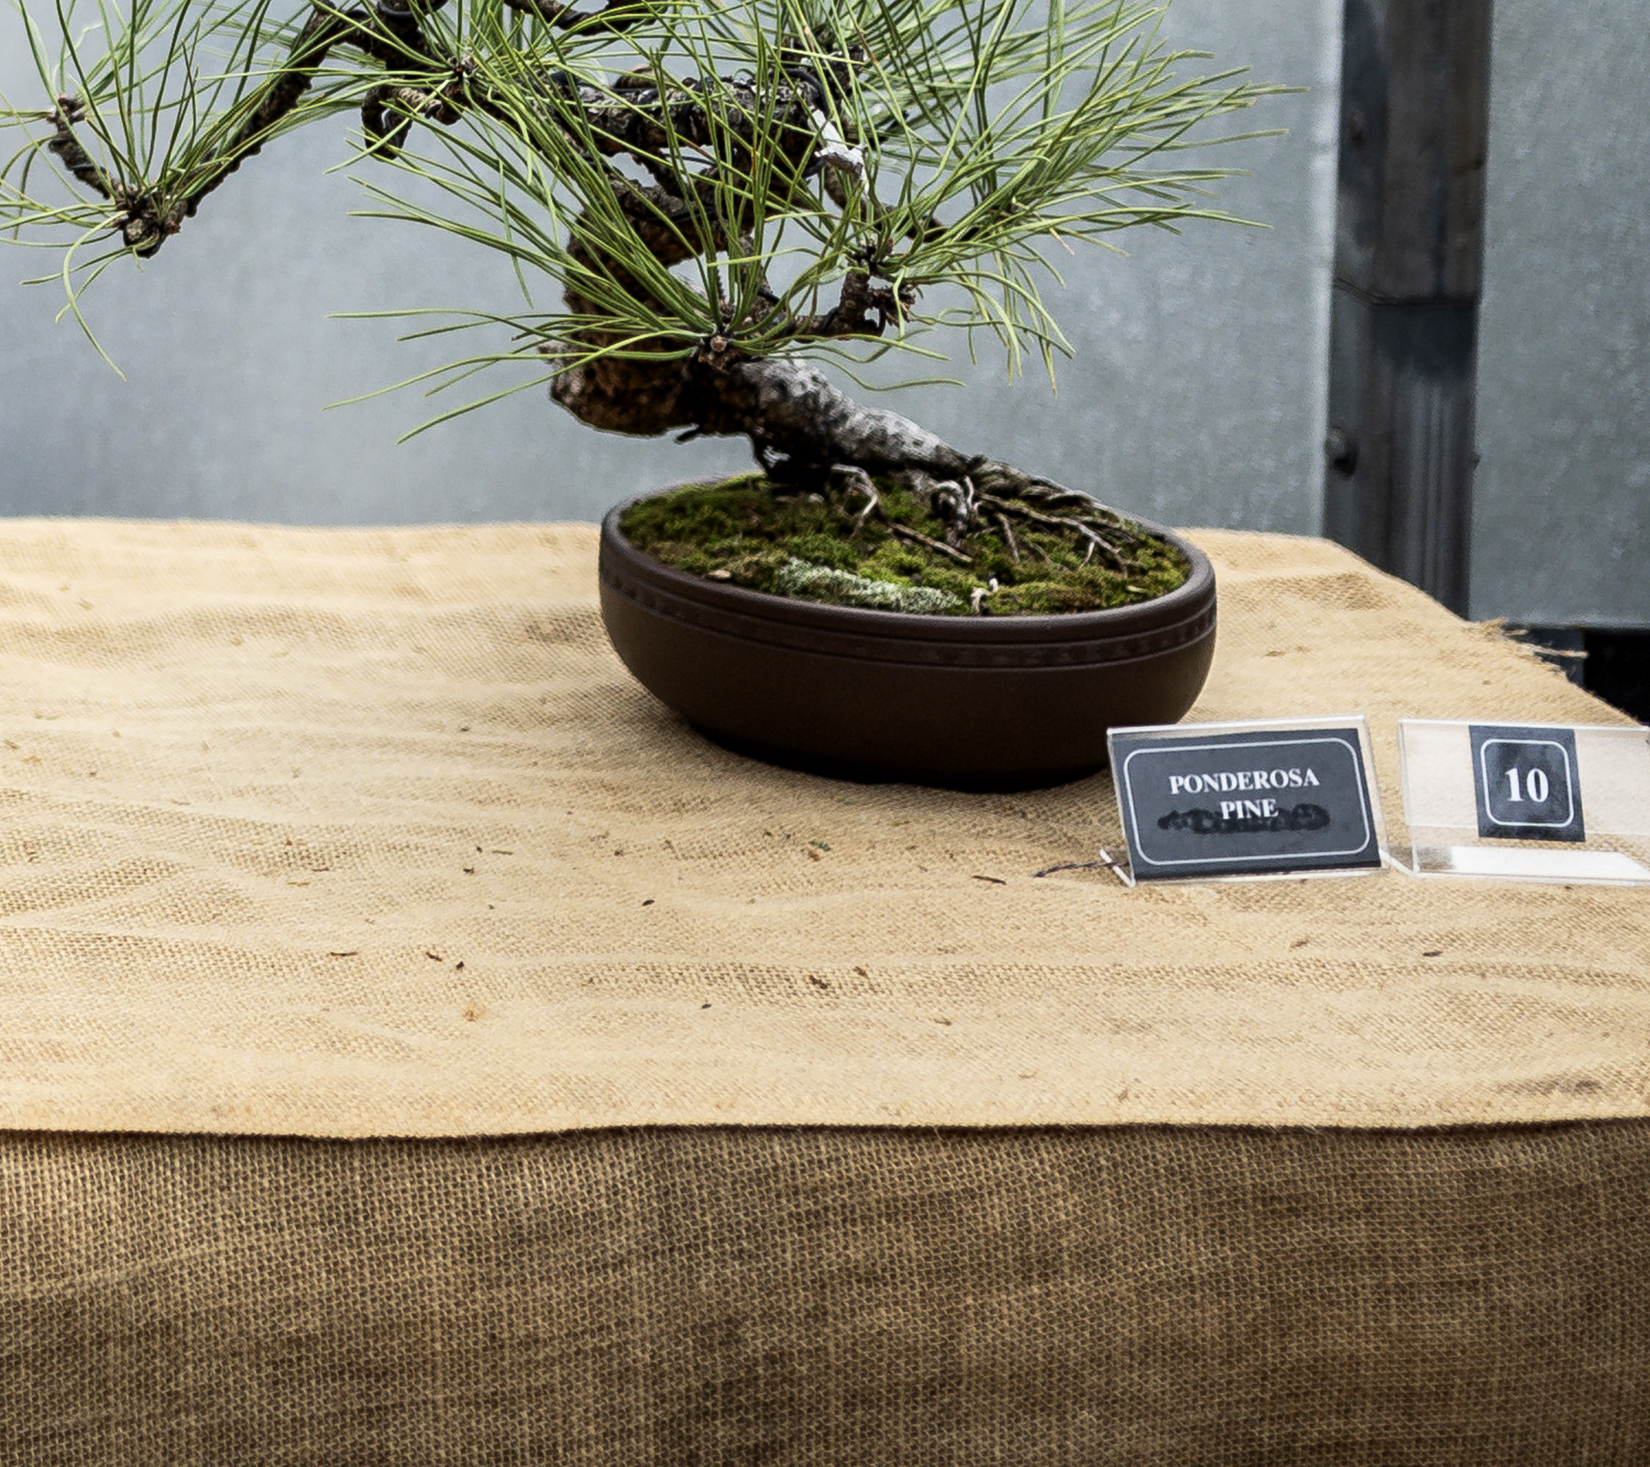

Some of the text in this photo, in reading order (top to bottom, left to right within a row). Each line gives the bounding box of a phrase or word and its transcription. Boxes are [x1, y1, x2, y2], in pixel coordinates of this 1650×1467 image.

[1168, 768, 1321, 795] PONDEROSA
[1504, 768, 1549, 803] 10
[1220, 799, 1279, 820] PINE
